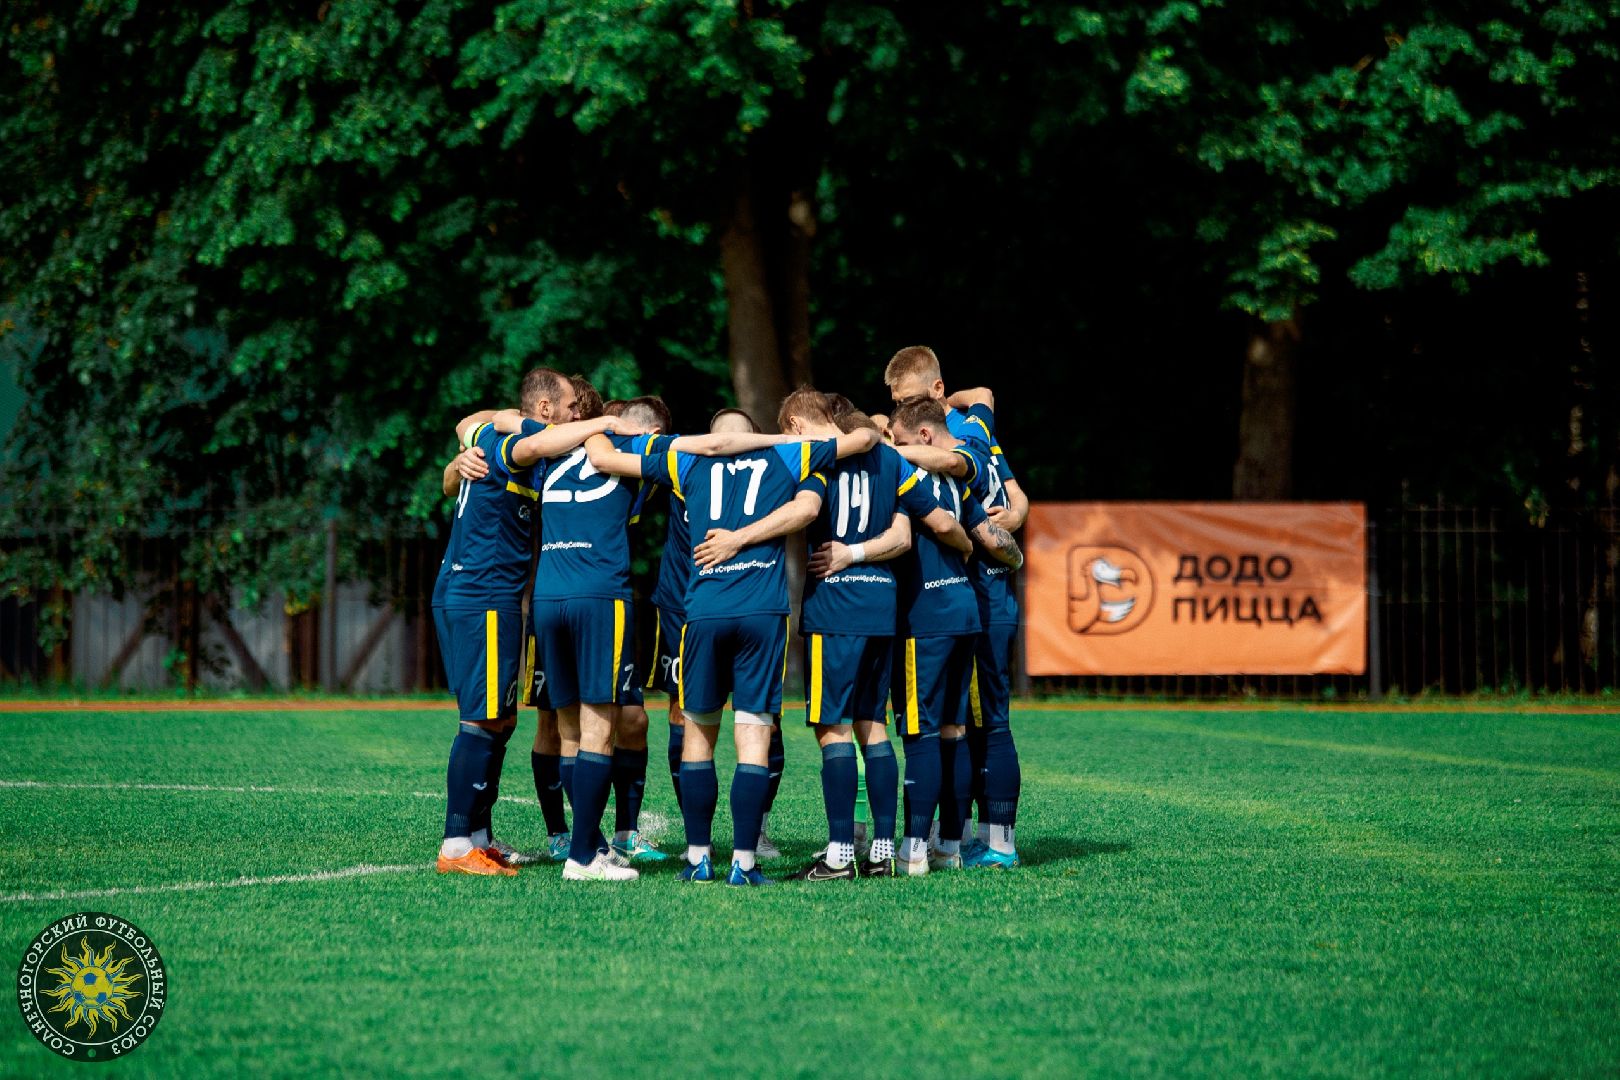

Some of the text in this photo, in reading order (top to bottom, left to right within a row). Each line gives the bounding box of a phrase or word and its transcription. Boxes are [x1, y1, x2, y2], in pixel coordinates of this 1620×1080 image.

[710, 458, 768, 520] 17
[836, 470, 870, 537] 14
[1173, 553, 1293, 588] ДОДО
[1172, 596, 1324, 628] ПИЦЦА
